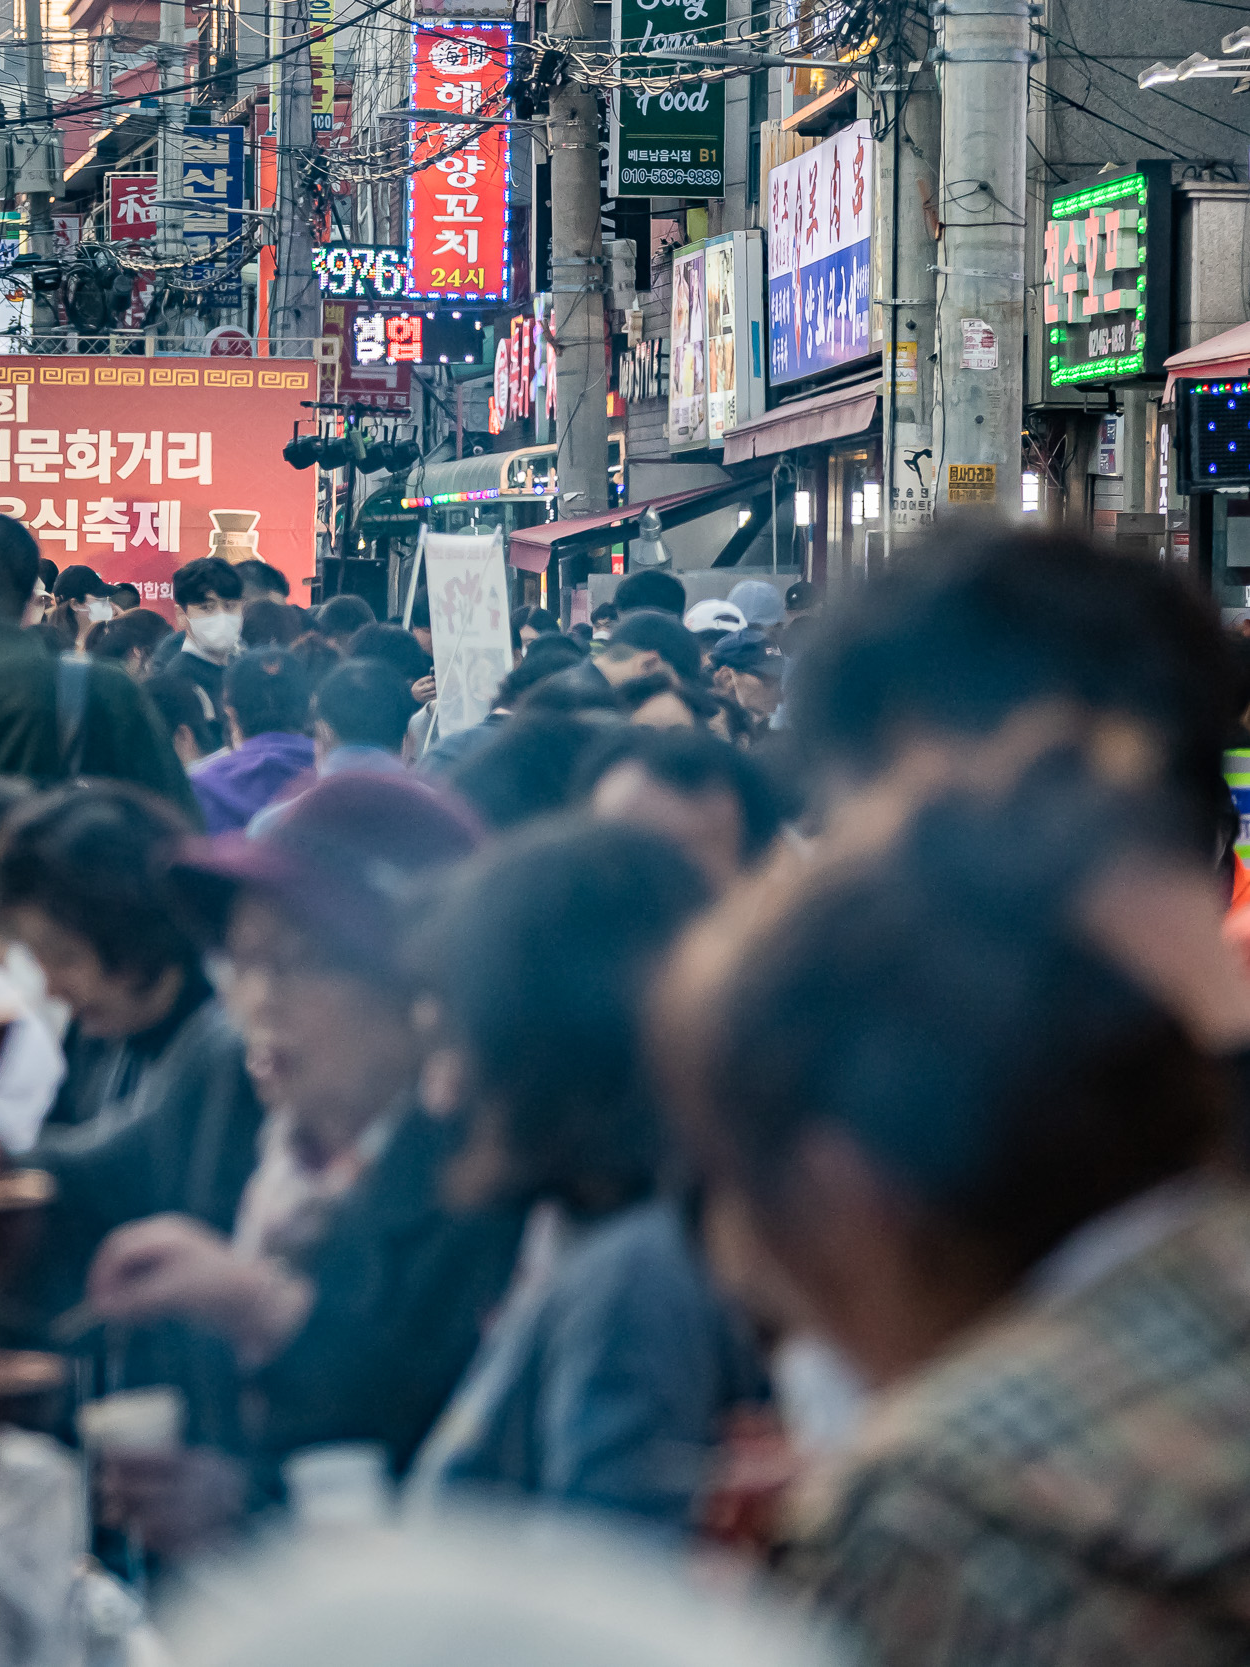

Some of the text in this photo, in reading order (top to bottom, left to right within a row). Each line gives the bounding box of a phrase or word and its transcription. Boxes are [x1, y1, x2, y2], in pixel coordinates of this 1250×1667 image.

[627, 149, 717, 162] 베트남음식점 B1
[621, 168, 721, 185] 010-5696-9889
[430, 267, 485, 290] 24시
